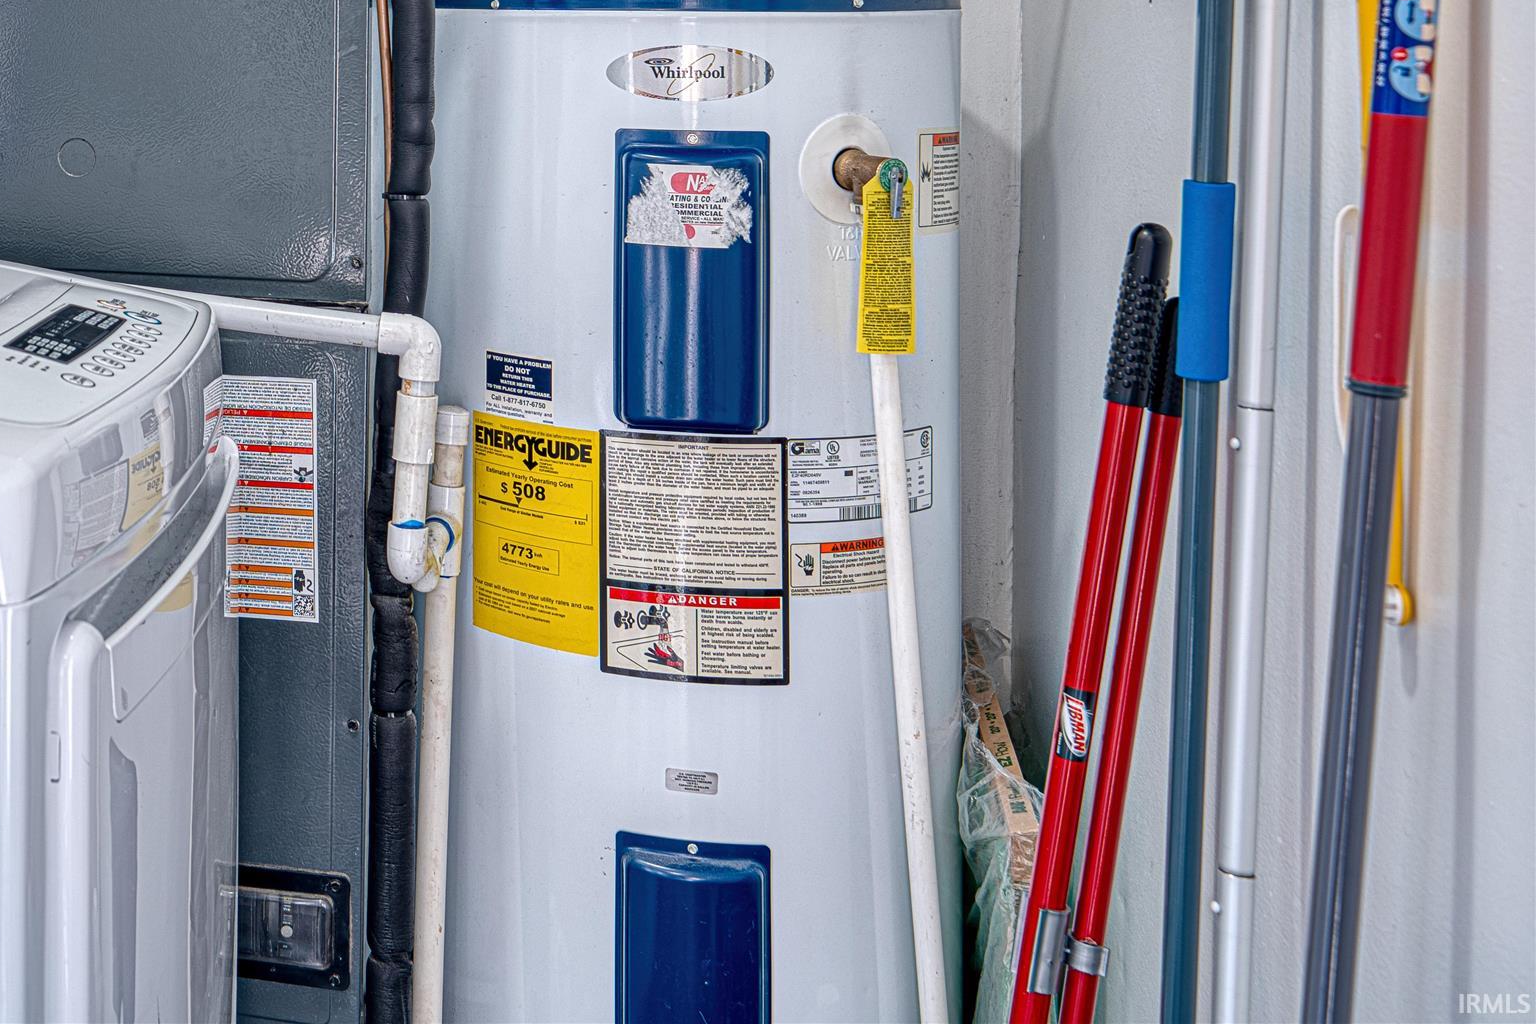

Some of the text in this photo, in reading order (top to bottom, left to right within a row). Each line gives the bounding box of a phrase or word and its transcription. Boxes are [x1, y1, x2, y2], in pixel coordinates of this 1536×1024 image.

[650, 66, 725, 82] Whirlpool
[826, 245, 860, 261] VALV
[516, 367, 530, 375] NOT
[486, 466, 573, 489] Estimated Yearly Operating Cost
[501, 481, 545, 501] $ 508
[502, 543, 534, 559] 4773
[840, 540, 883, 550] WARNING
[502, 586, 519, 596] depend
[678, 596, 737, 606] DANGER
[1066, 696, 1086, 752] LIBMAN
